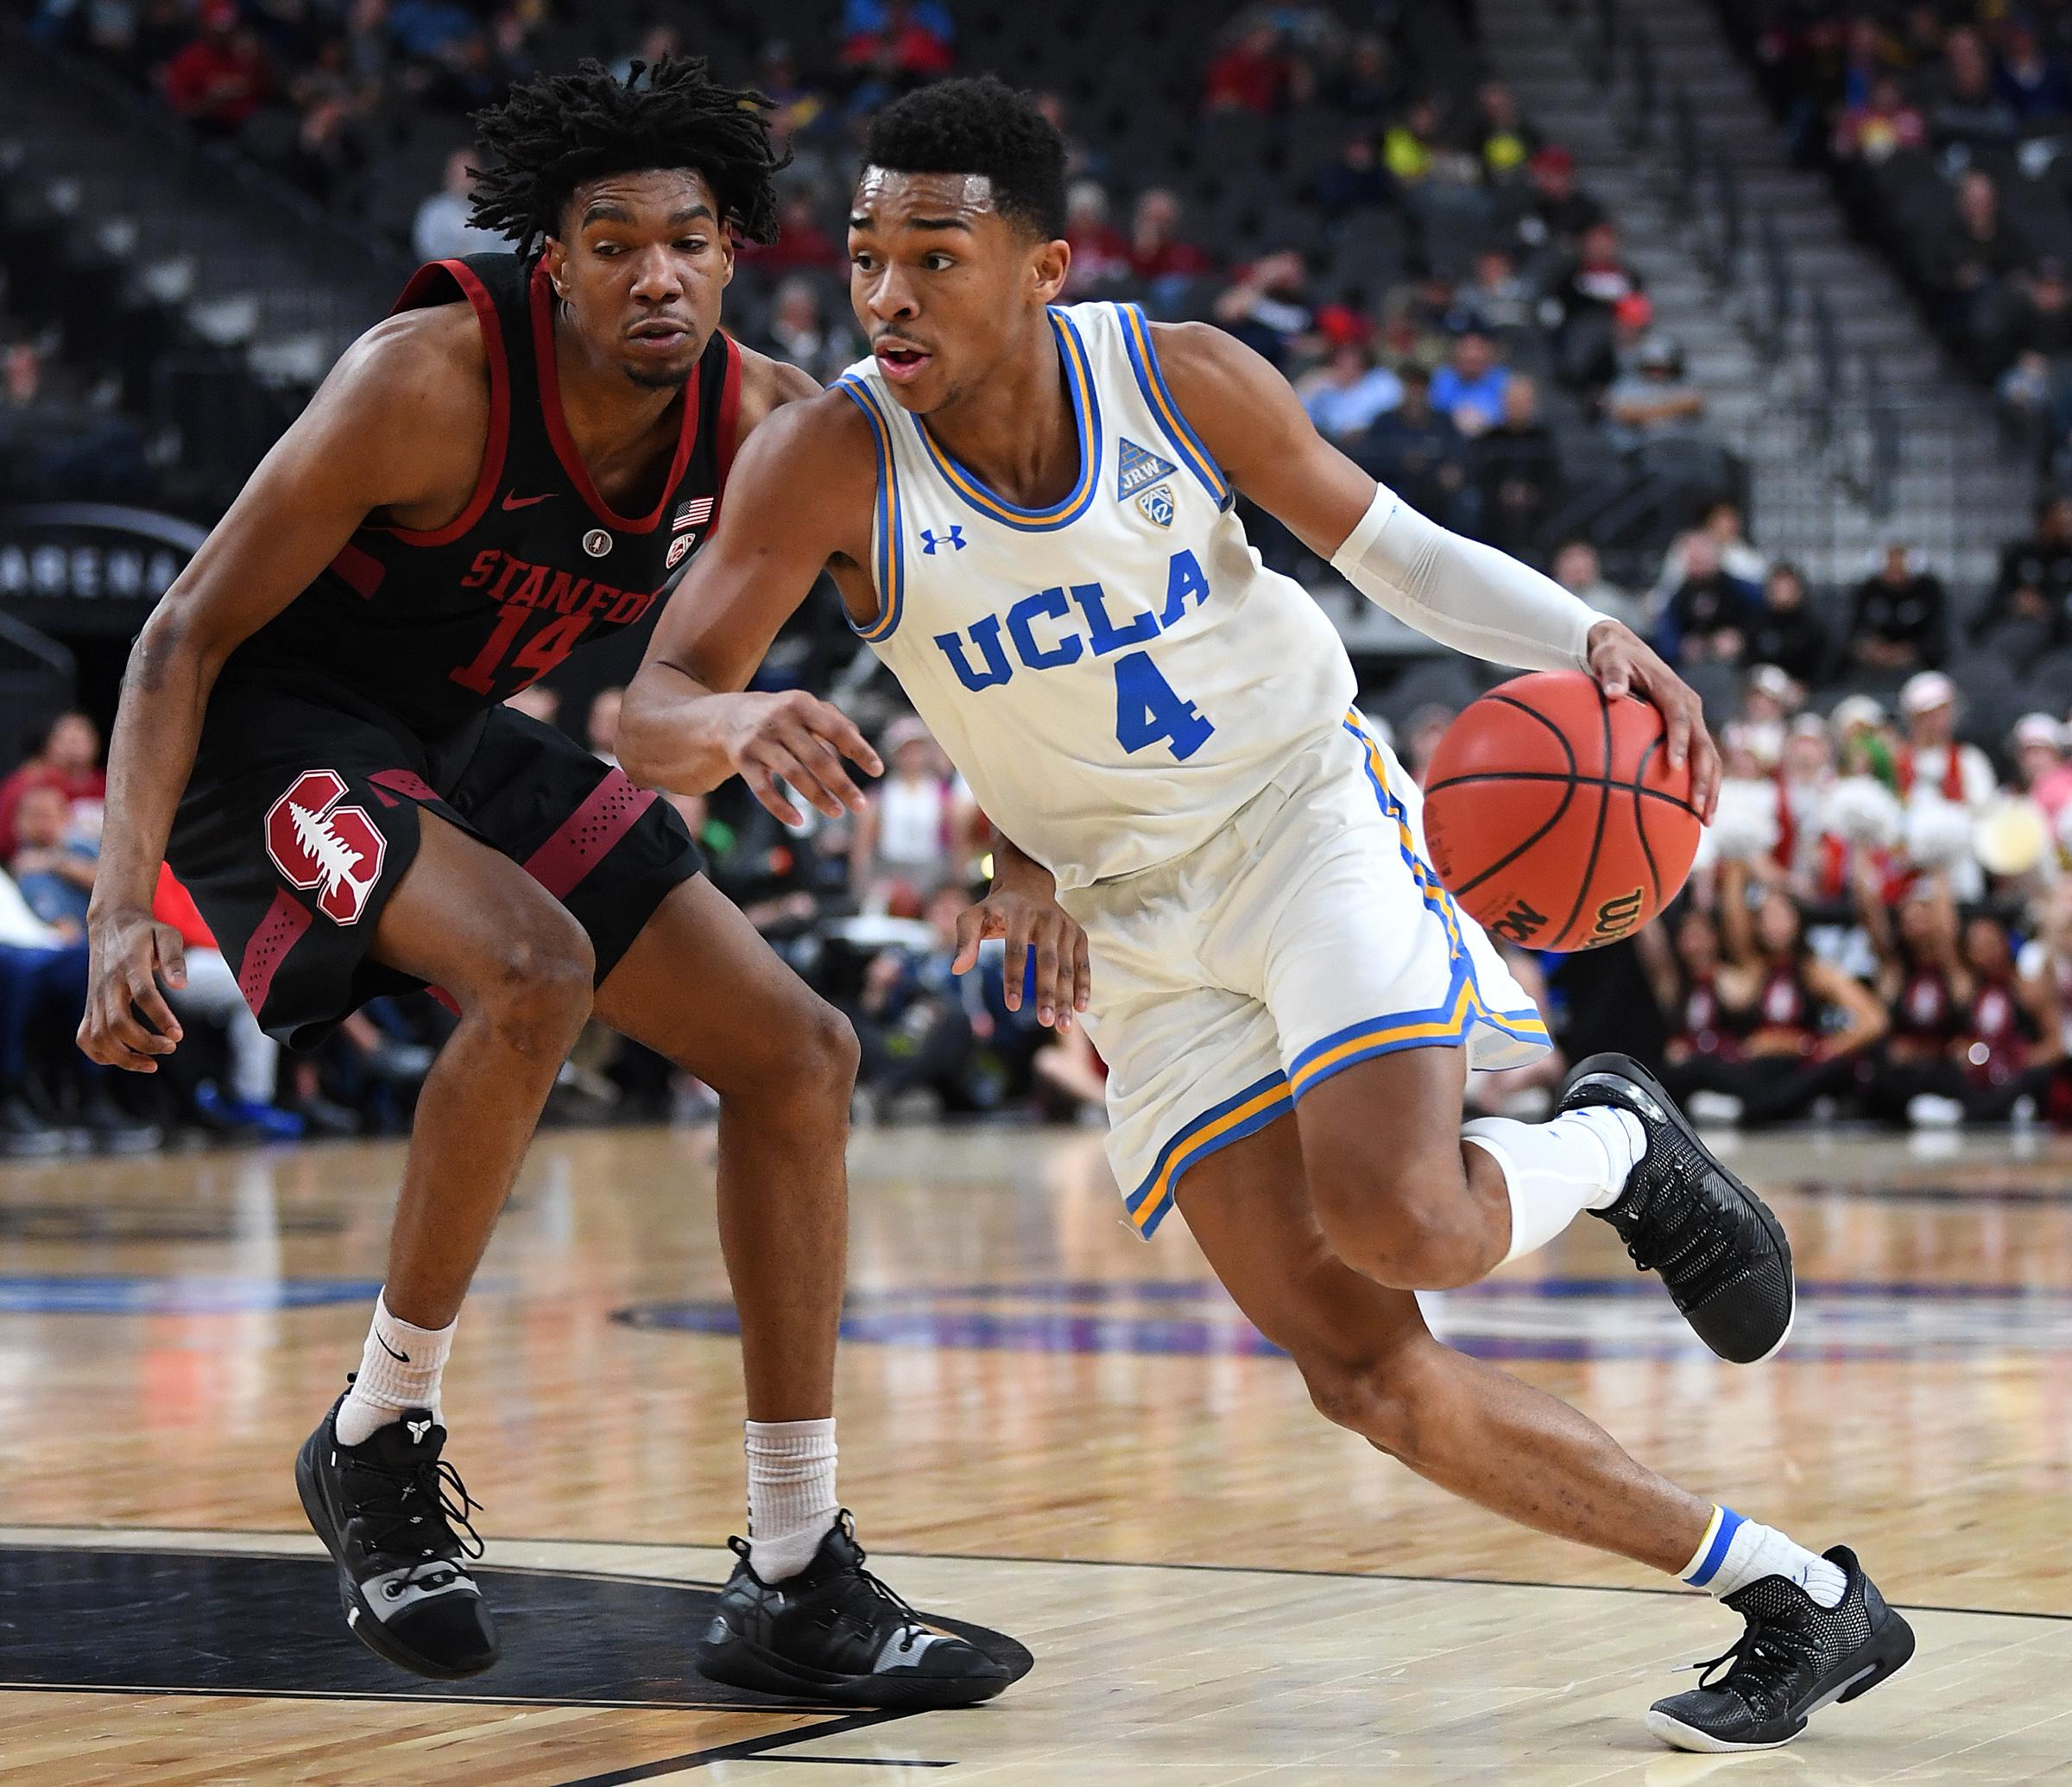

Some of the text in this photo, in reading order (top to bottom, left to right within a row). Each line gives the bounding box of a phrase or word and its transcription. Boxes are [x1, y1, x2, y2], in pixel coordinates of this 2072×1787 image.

[1121, 458, 1160, 489] JRW
[1152, 503, 1173, 524] 12
[461, 550, 663, 624] STANFO
[933, 548, 1210, 692] UCLA
[449, 605, 593, 696] 14
[1114, 650, 1216, 761] 4
